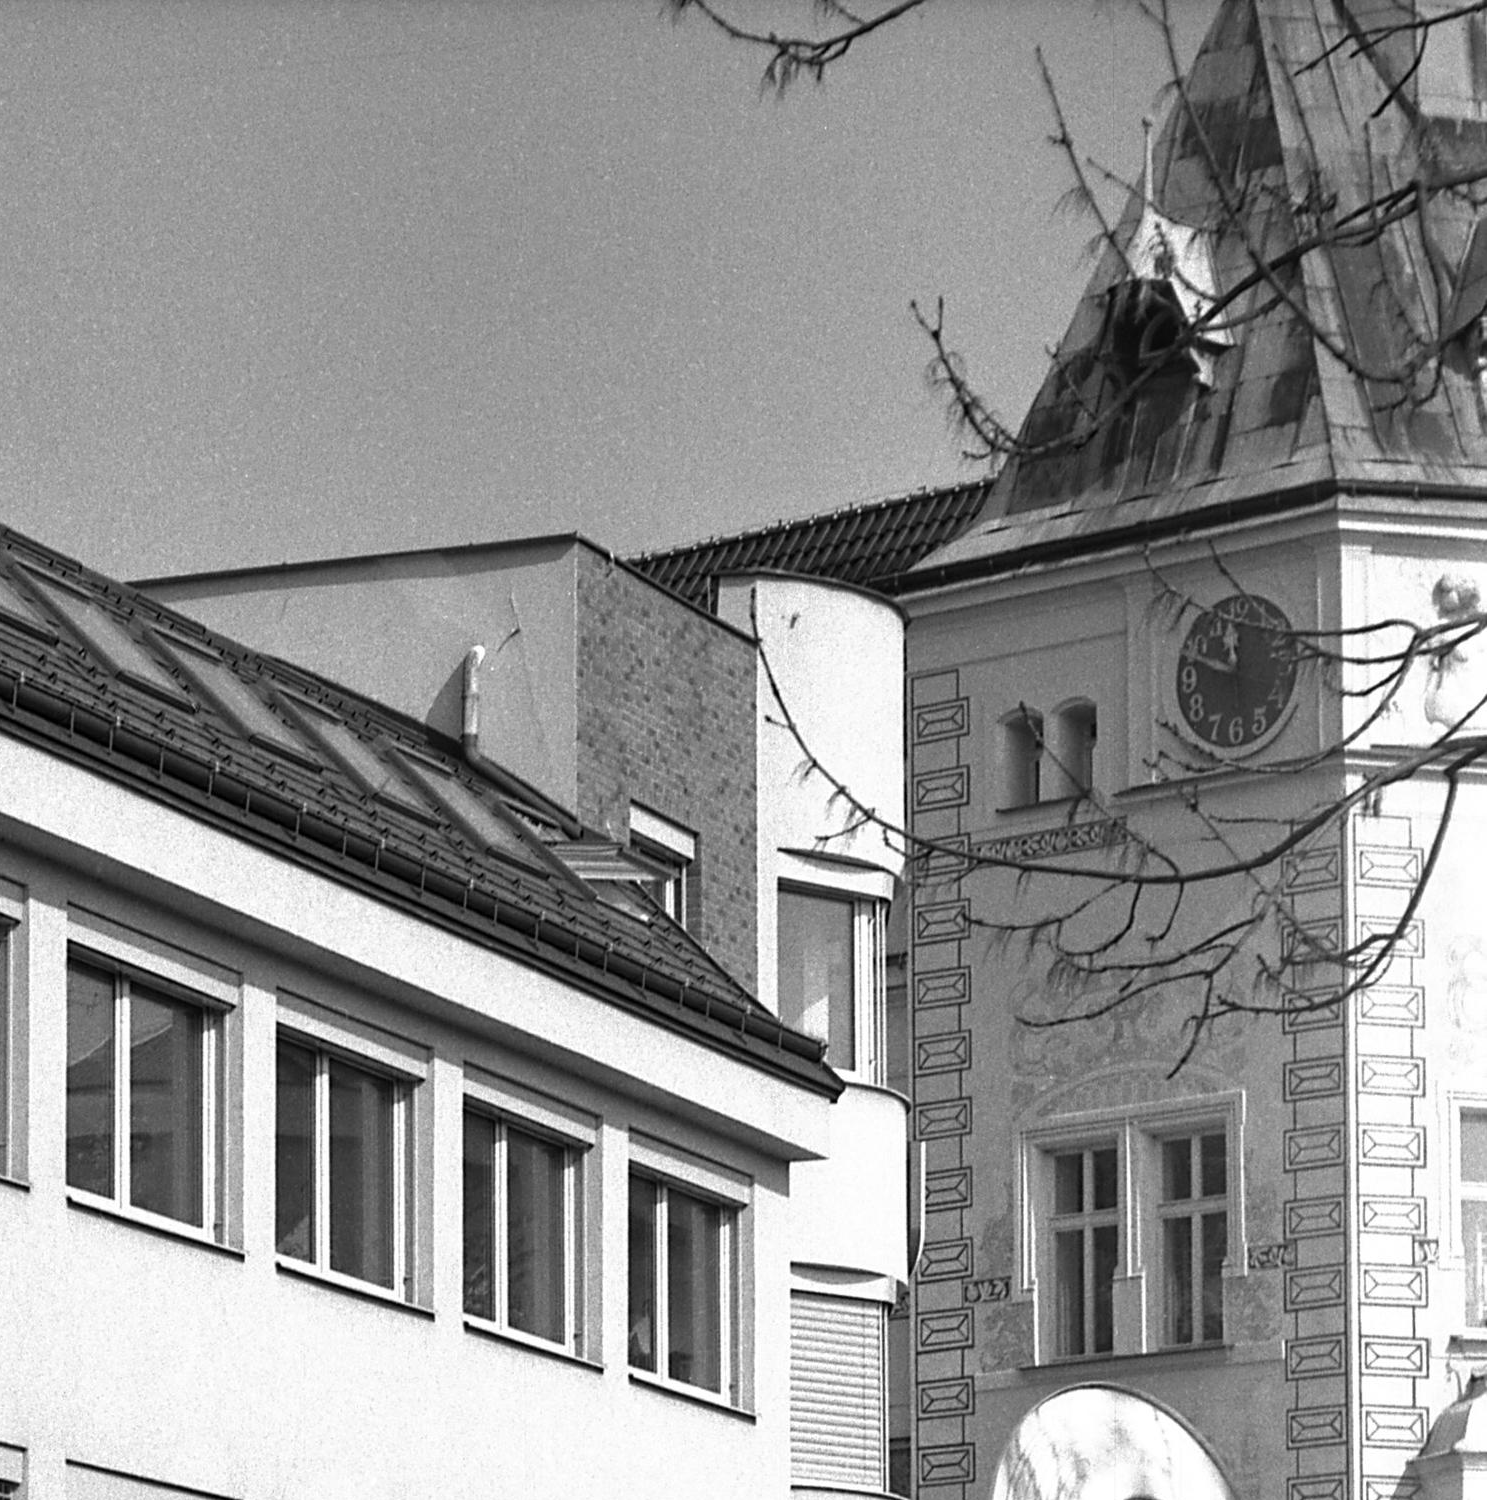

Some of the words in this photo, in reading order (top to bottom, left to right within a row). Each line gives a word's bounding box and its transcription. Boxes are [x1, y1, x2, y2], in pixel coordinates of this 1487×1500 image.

[1182, 666, 1197, 693] 9
[1189, 693, 1204, 721] 8
[1252, 706, 1267, 735] 5
[1208, 713, 1223, 741] 7
[1229, 716, 1243, 744] 6
